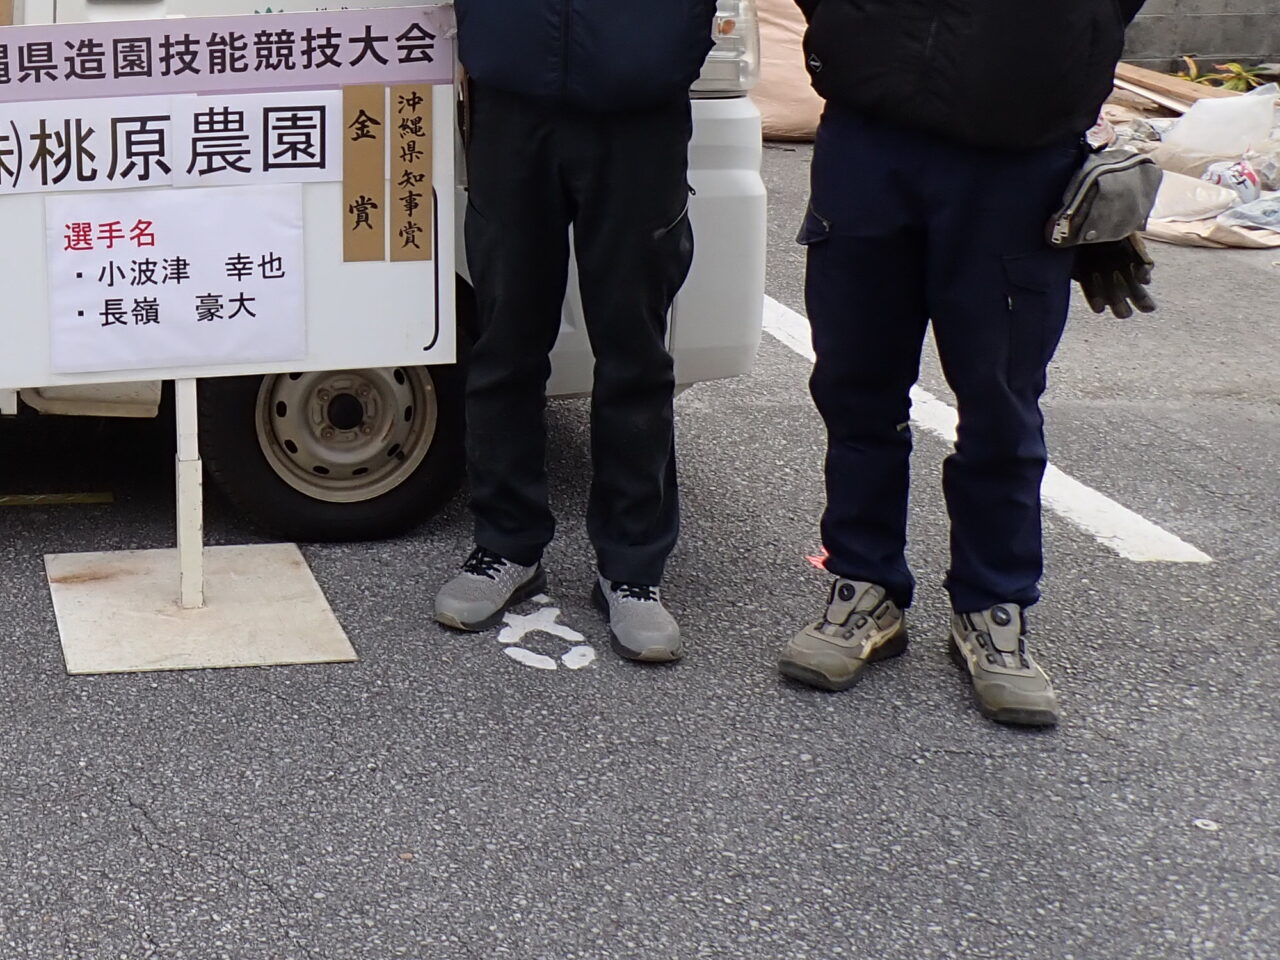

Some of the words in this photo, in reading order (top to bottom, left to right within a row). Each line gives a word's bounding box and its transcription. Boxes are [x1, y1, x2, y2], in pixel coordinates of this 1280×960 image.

[398, 91, 426, 249] 沖縄県知事賞
[64, 219, 155, 251] 選手名
[225, 251, 286, 282] 幸也
[195, 292, 257, 322] 豪大
